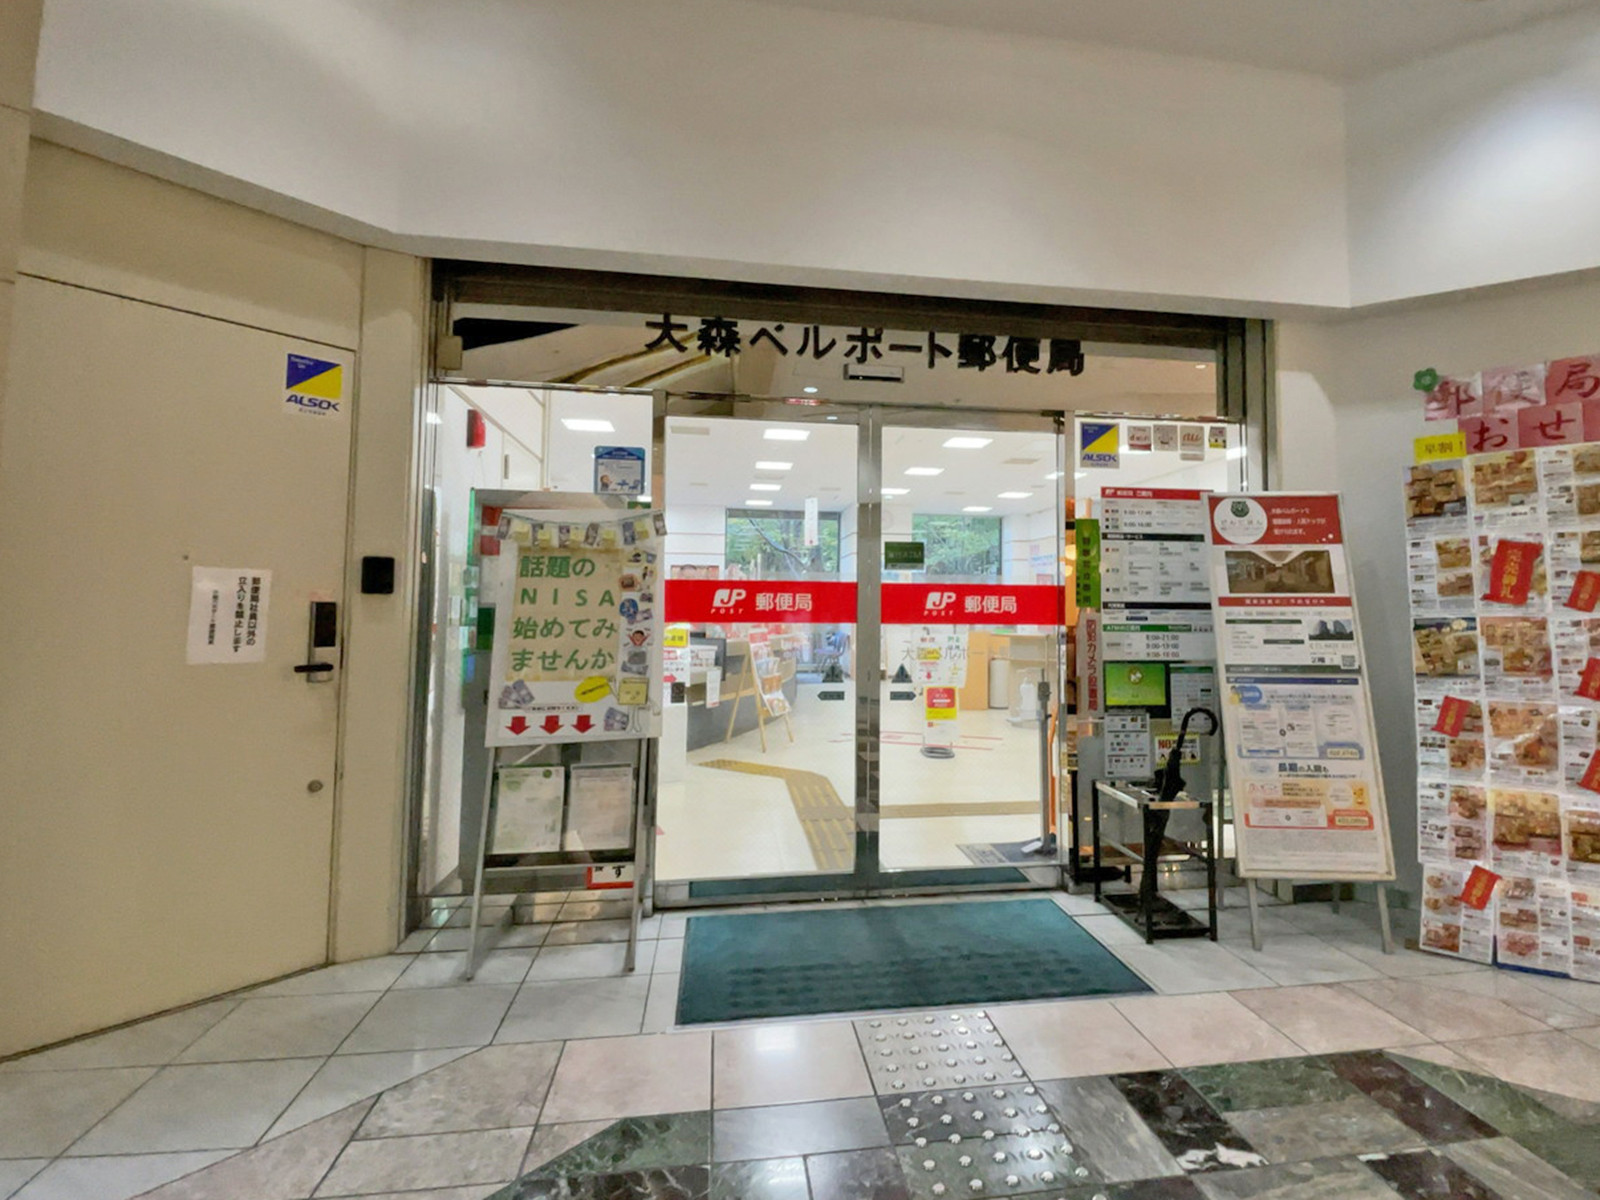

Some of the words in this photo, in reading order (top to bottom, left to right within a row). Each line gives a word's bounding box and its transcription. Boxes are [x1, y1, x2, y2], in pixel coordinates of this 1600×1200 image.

[644, 312, 1085, 376] 大森ベルポート郵便局
[286, 394, 340, 412] ALSOK
[1082, 453, 1117, 463] ALSOK
[519, 555, 595, 578] 話題の
[520, 588, 616, 607] NISA
[755, 592, 813, 612] 郵便局
[964, 595, 1018, 614] 郵便局
[710, 607, 744, 615] POST
[512, 617, 618, 640] 始めてみ
[511, 650, 614, 672] ませんか
